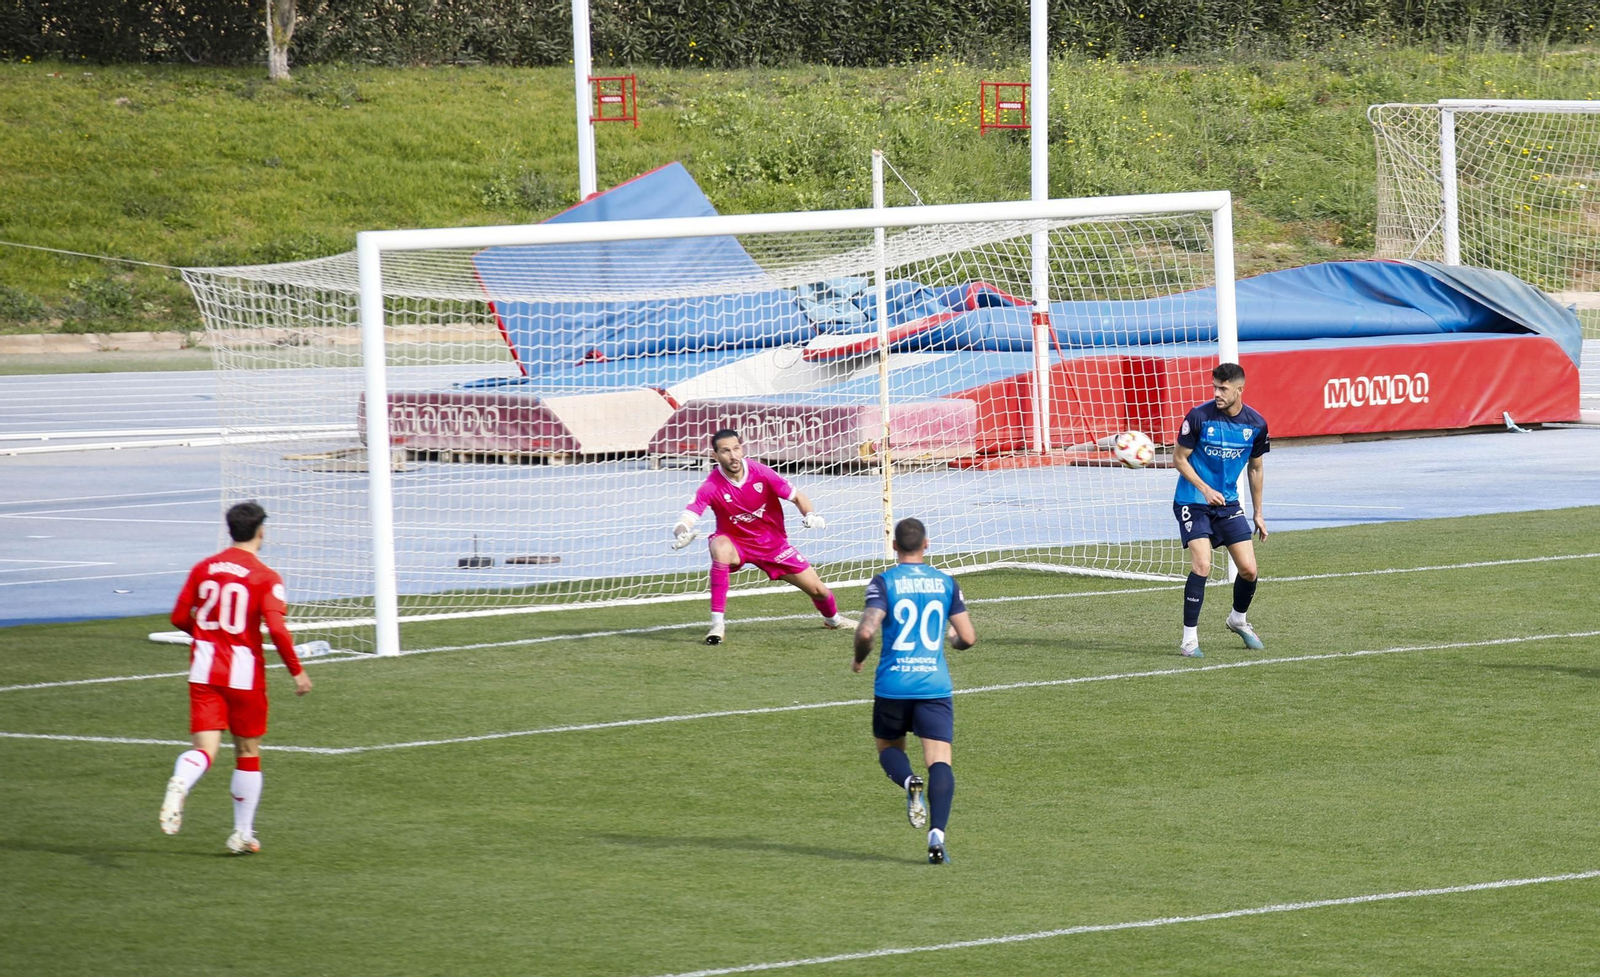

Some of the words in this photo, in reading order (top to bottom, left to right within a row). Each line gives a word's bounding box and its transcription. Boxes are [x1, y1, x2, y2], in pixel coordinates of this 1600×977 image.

[1323, 372, 1430, 409] MONDO
[390, 406, 500, 437] MONDO
[1181, 505, 1192, 521] 8
[196, 579, 249, 635] 20
[891, 598, 944, 651] 20
